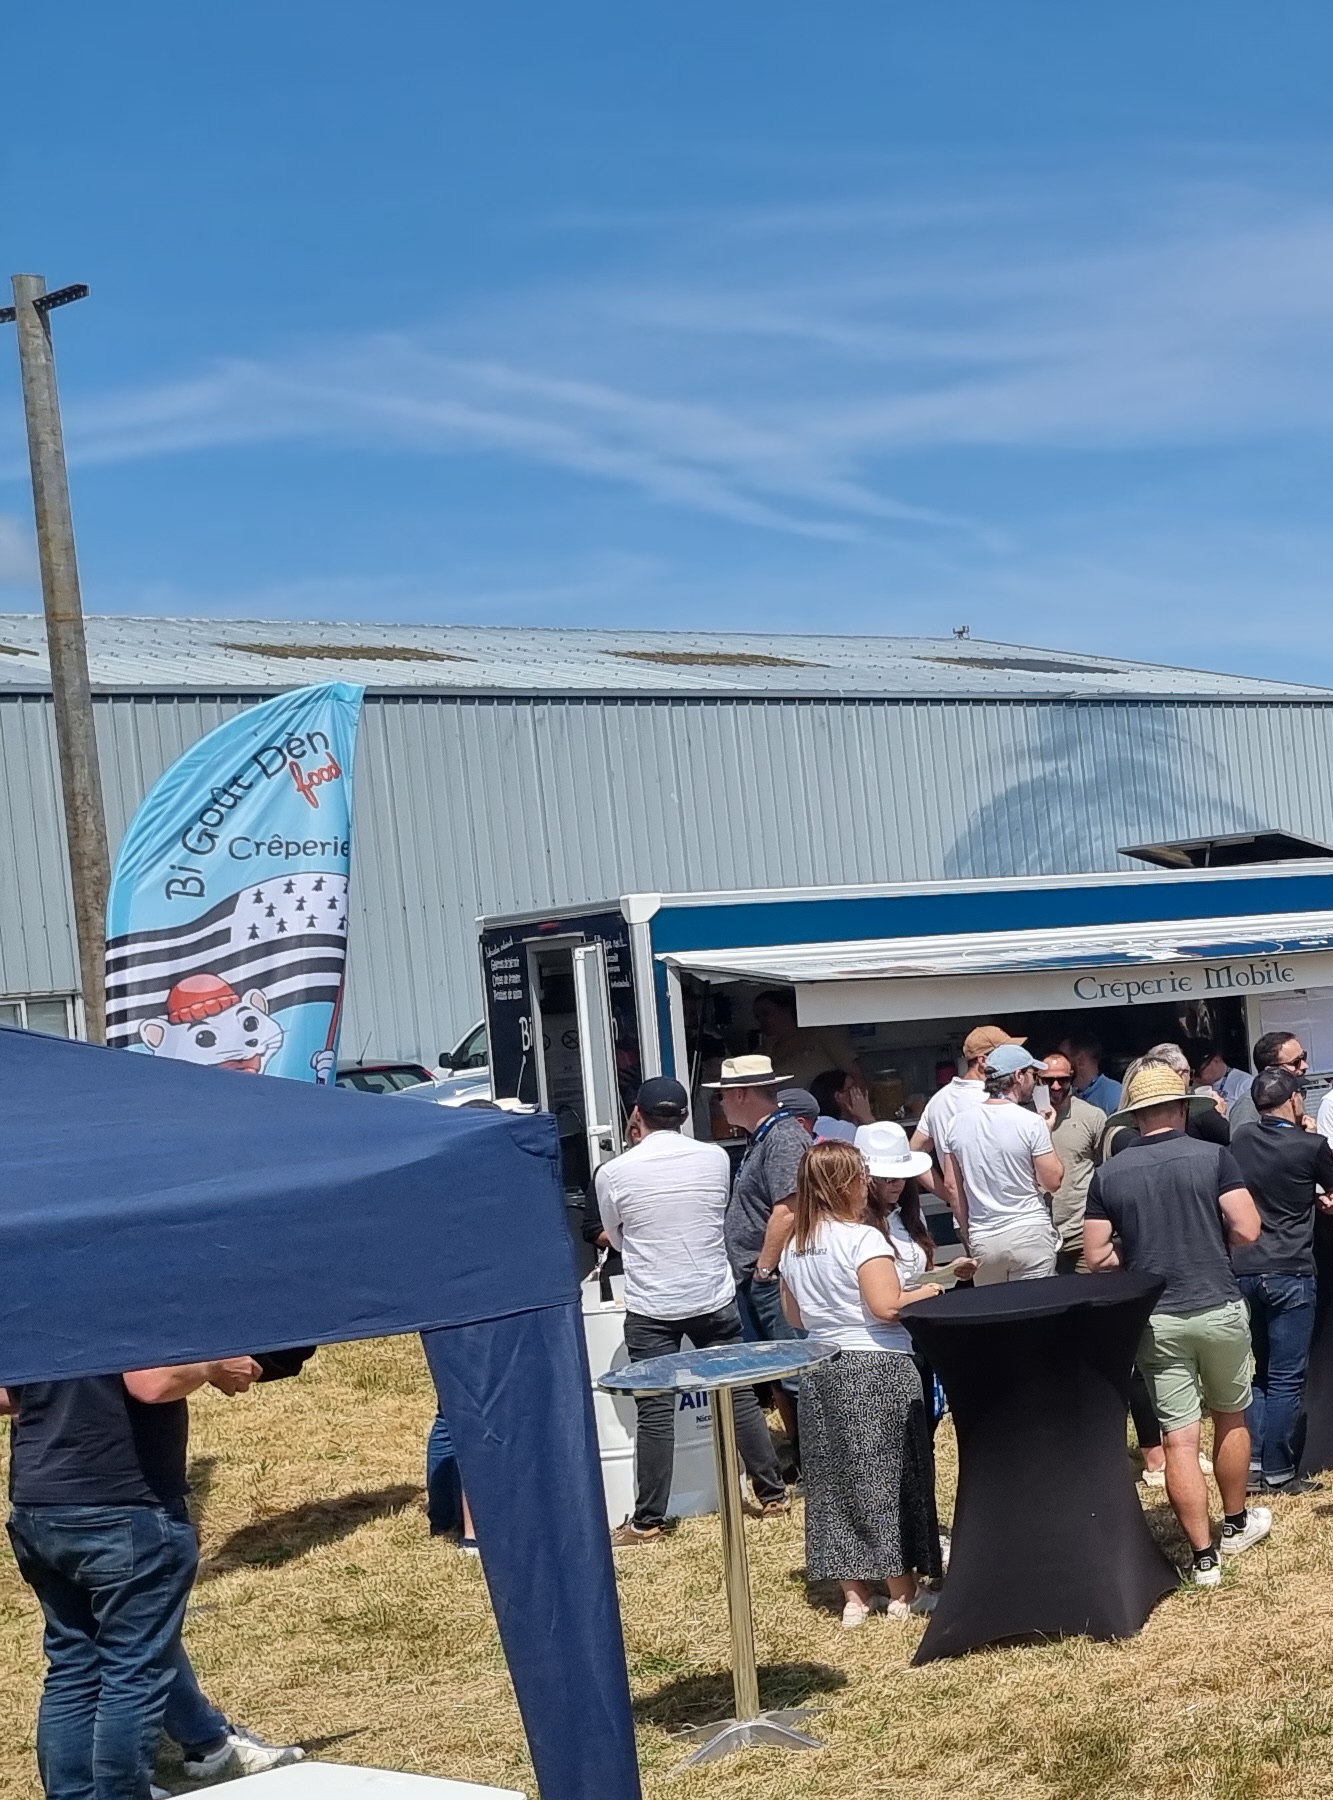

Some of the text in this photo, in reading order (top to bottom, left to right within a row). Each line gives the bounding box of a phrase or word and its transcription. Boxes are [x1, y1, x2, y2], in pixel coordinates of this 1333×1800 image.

[289, 751, 342, 809] food
[165, 730, 330, 901] Bi Goût Dèn
[228, 833, 350, 861] Crêperie
[1073, 961, 1295, 1004] Crêperie Mobile
[519, 1016, 533, 1051] Bi
